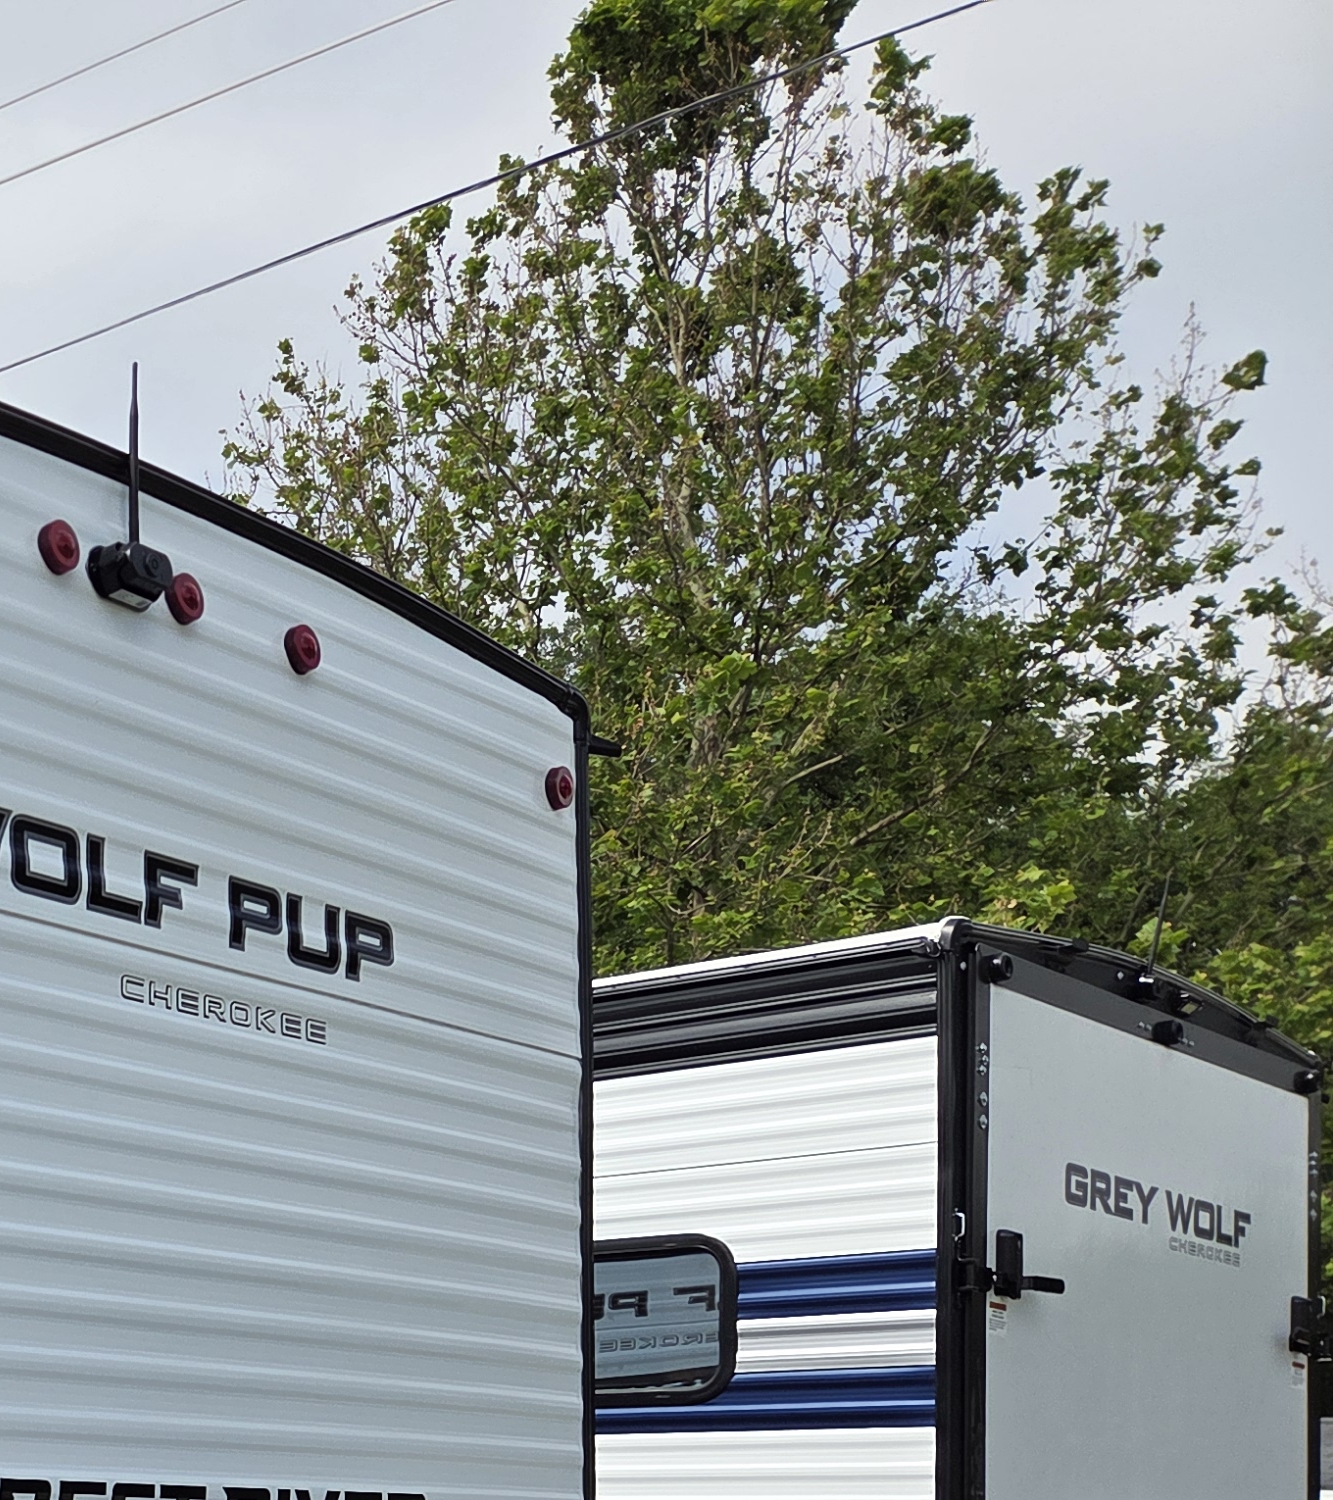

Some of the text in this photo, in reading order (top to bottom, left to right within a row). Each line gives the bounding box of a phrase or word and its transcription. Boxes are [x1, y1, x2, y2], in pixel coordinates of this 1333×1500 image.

[228, 874, 395, 982] PUP
[120, 973, 328, 1046] CHEROKEE
[1064, 1161, 1252, 1249] GREY WOLF
[1168, 1236, 1242, 1268] CHEROKEE
